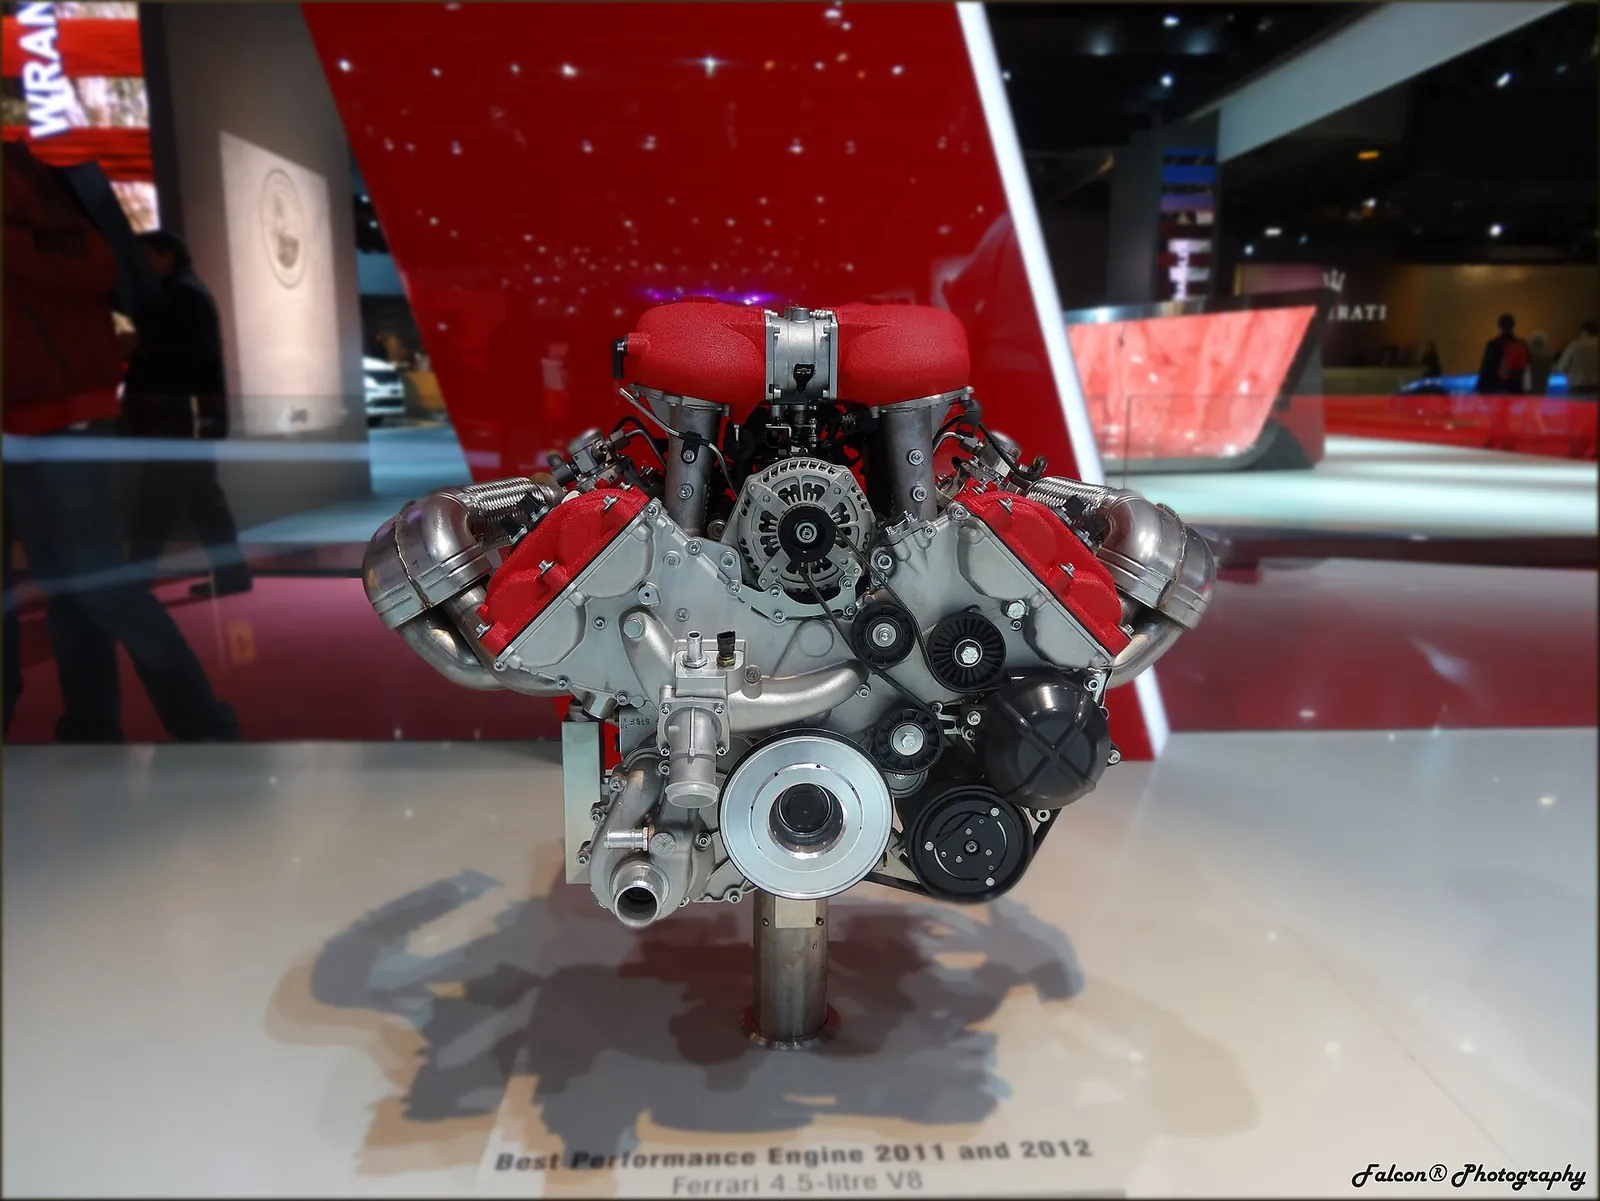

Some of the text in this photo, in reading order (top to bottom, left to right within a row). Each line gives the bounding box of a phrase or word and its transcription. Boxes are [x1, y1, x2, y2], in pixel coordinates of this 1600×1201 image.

[494, 1139, 1094, 1171] Best Performance Engine 2011 and 2012
[671, 1170, 924, 1196] Ferrari 4.5-litre V8
